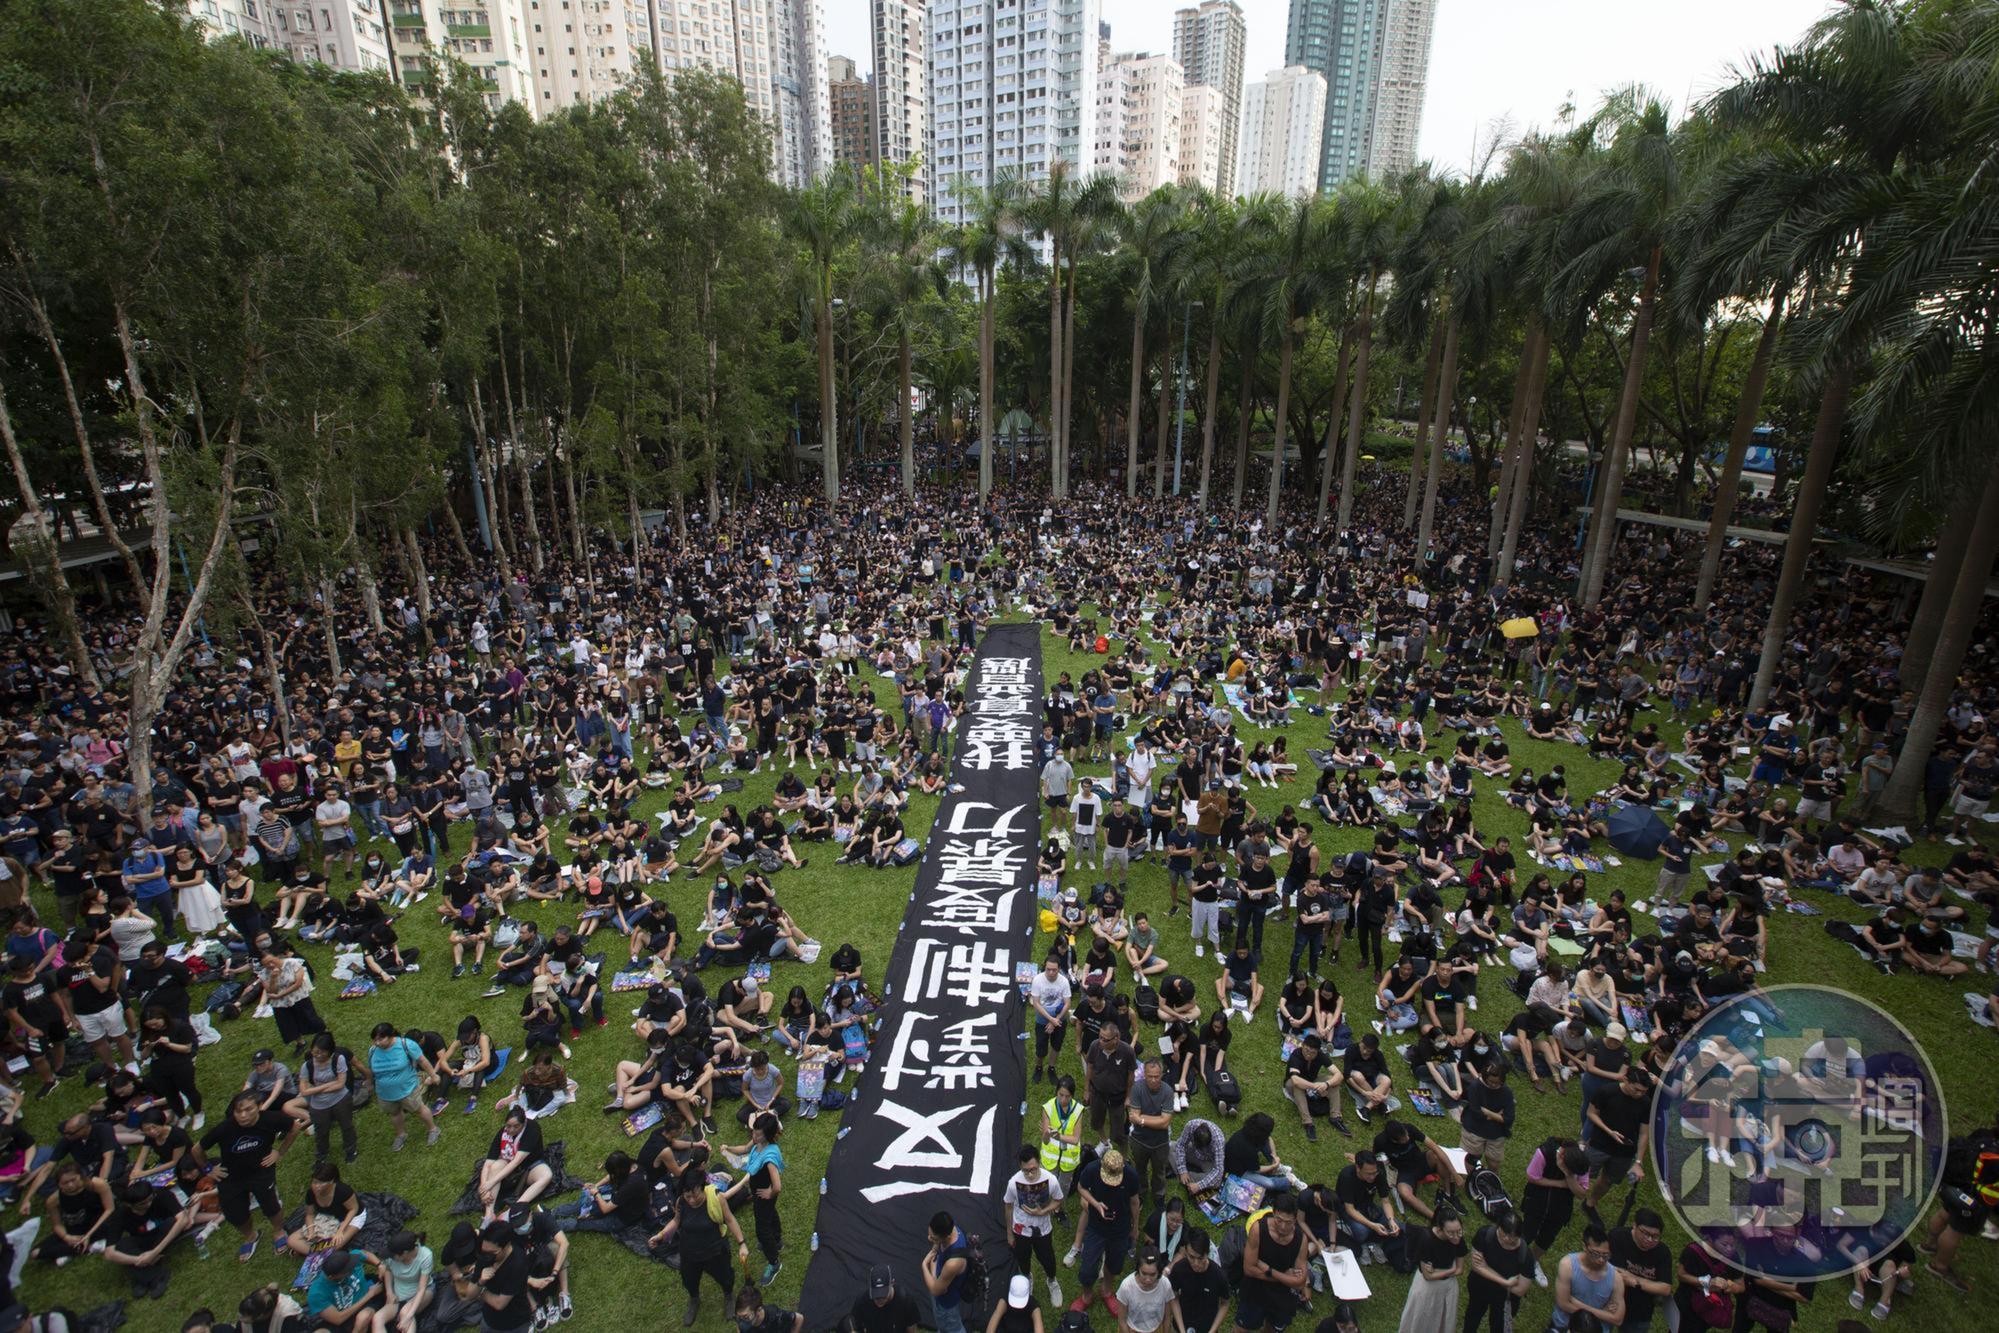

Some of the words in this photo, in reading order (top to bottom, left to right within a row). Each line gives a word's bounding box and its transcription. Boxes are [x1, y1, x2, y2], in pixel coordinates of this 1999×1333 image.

[961, 656, 1034, 771] 我要真普選
[859, 801, 1028, 1204] 反對制度暴力
